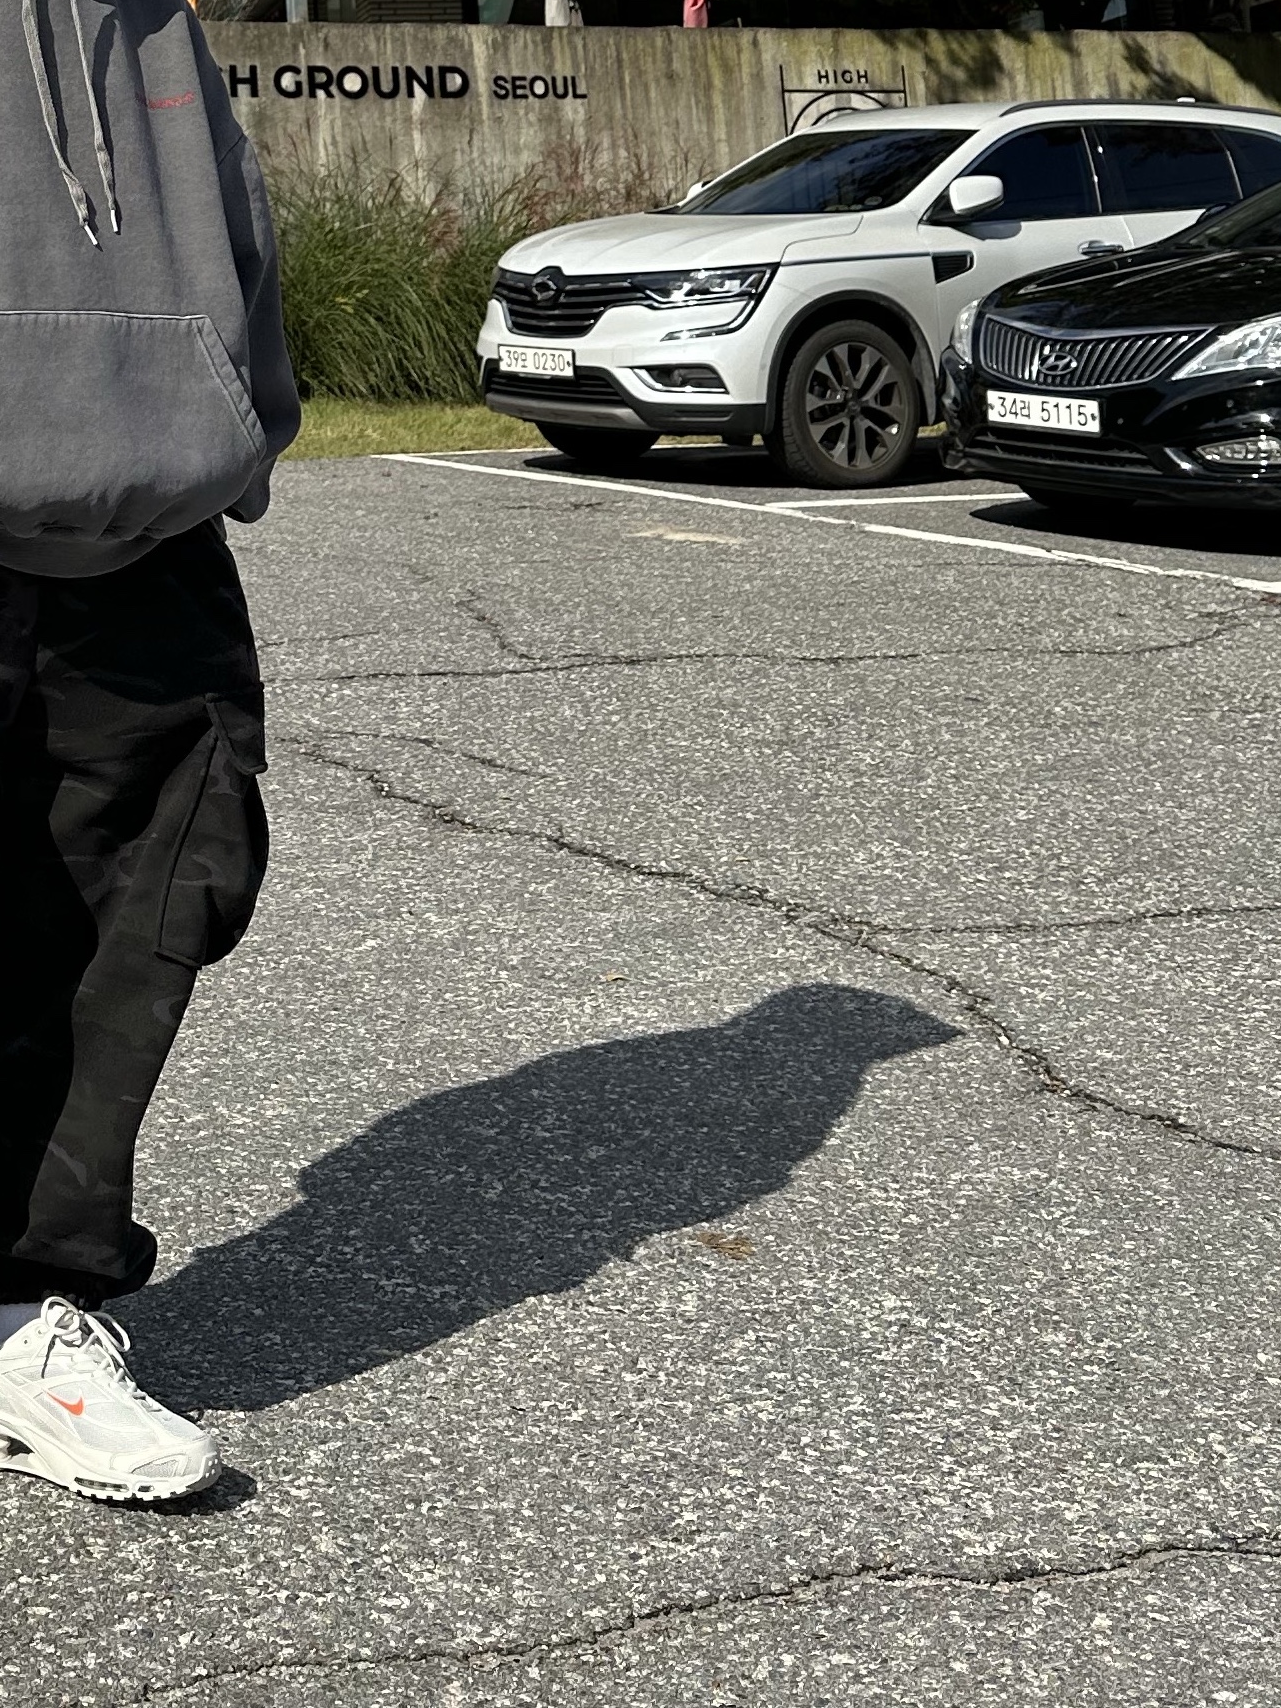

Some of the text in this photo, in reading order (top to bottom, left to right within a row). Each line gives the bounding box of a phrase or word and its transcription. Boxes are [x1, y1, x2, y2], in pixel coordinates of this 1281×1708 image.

[273, 65, 469, 100] GROUND
[492, 75, 588, 100] SEOUL
[817, 69, 869, 85] HIGH
[533, 351, 566, 372] 0230
[1040, 400, 1088, 427] 5115
